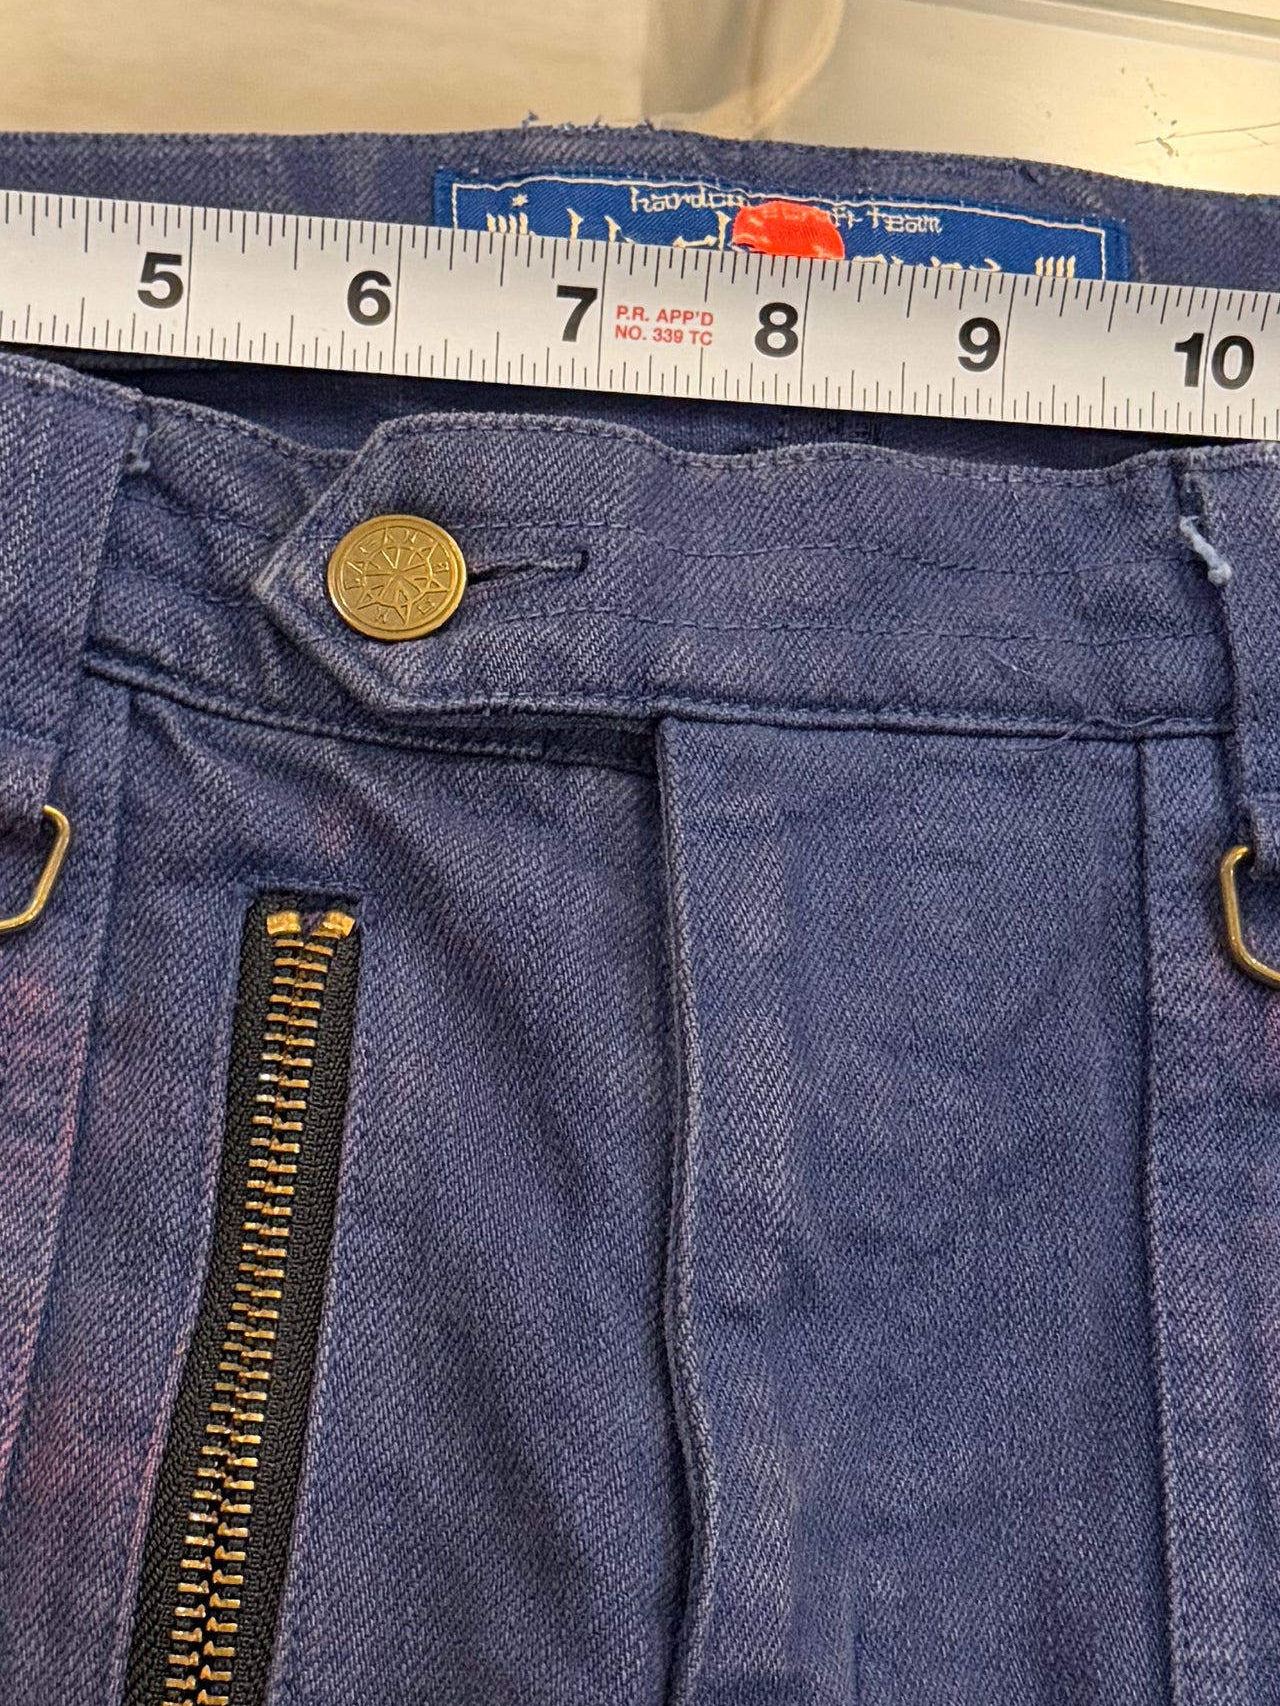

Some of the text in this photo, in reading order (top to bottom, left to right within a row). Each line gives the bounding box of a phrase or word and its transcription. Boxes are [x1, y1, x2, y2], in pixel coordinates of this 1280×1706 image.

[136, 251, 184, 308] 5
[346, 269, 392, 326] 6
[556, 283, 599, 342] 7
[615, 324, 713, 346] NO. 339 TC
[616, 305, 714, 326] P.R. APP'D
[753, 302, 799, 359] 8
[957, 316, 1001, 373] 9
[1174, 331, 1256, 391] 10
